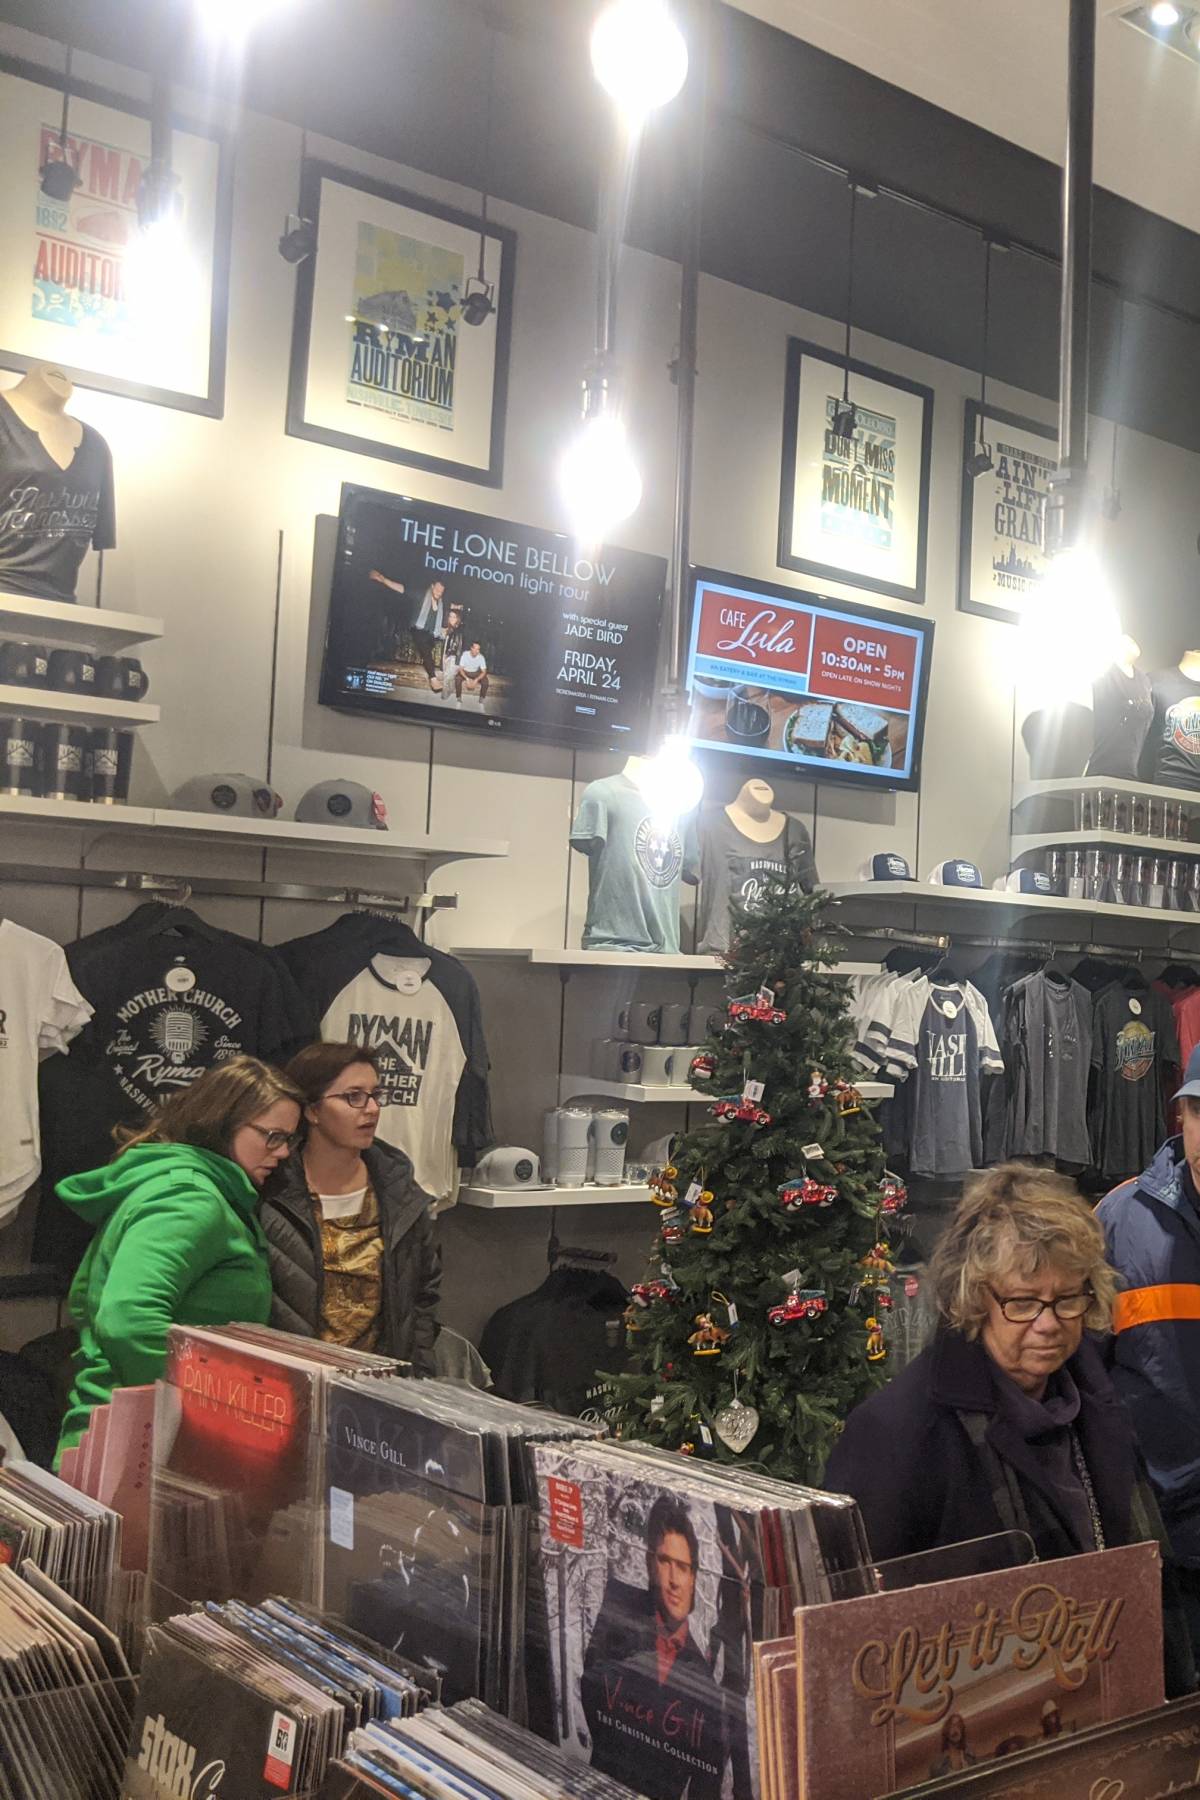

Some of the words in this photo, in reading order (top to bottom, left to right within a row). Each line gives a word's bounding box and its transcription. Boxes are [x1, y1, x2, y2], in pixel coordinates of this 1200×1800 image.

[353, 321, 456, 371] RYMAN
[350, 342, 456, 407] AUDITORIUM
[865, 441, 895, 474] MISS
[823, 464, 894, 519] MOMENT
[401, 518, 445, 549] THE
[452, 530, 518, 565] LONE
[525, 547, 615, 586] BELLOW
[425, 552, 458, 573] half
[463, 563, 514, 585] moon
[519, 572, 554, 594] light
[559, 584, 590, 601] tour
[564, 623, 593, 640] JADE
[596, 629, 623, 645] BIRD
[580, 615, 607, 626] special
[717, 610, 796, 658] Lula
[720, 608, 747, 629] CAFE
[564, 650, 617, 675] FRIDAY,
[843, 636, 887, 660] OPEN
[556, 666, 598, 687] APRIL
[601, 674, 621, 690] 24
[821, 670, 838, 680] OPEN
[838, 674, 853, 684] LATE
[853, 677, 863, 685] ON
[863, 678, 881, 689] SHOW
[882, 681, 902, 693] NIGHTS
[116, 988, 178, 1023] MOTHER
[183, 988, 243, 1030] CHURCH
[347, 1013, 434, 1071] RYMAN
[131, 1054, 206, 1087] Ryma
[183, 1365, 221, 1412] PAIN
[227, 1380, 287, 1436] KILLER
[344, 1426, 377, 1456] VINCE
[380, 1440, 407, 1468] GILL
[852, 1621, 954, 1727] Let
[968, 1601, 1004, 1671] it
[1012, 1583, 1125, 1691] Roll
[138, 1713, 198, 1800] stax
